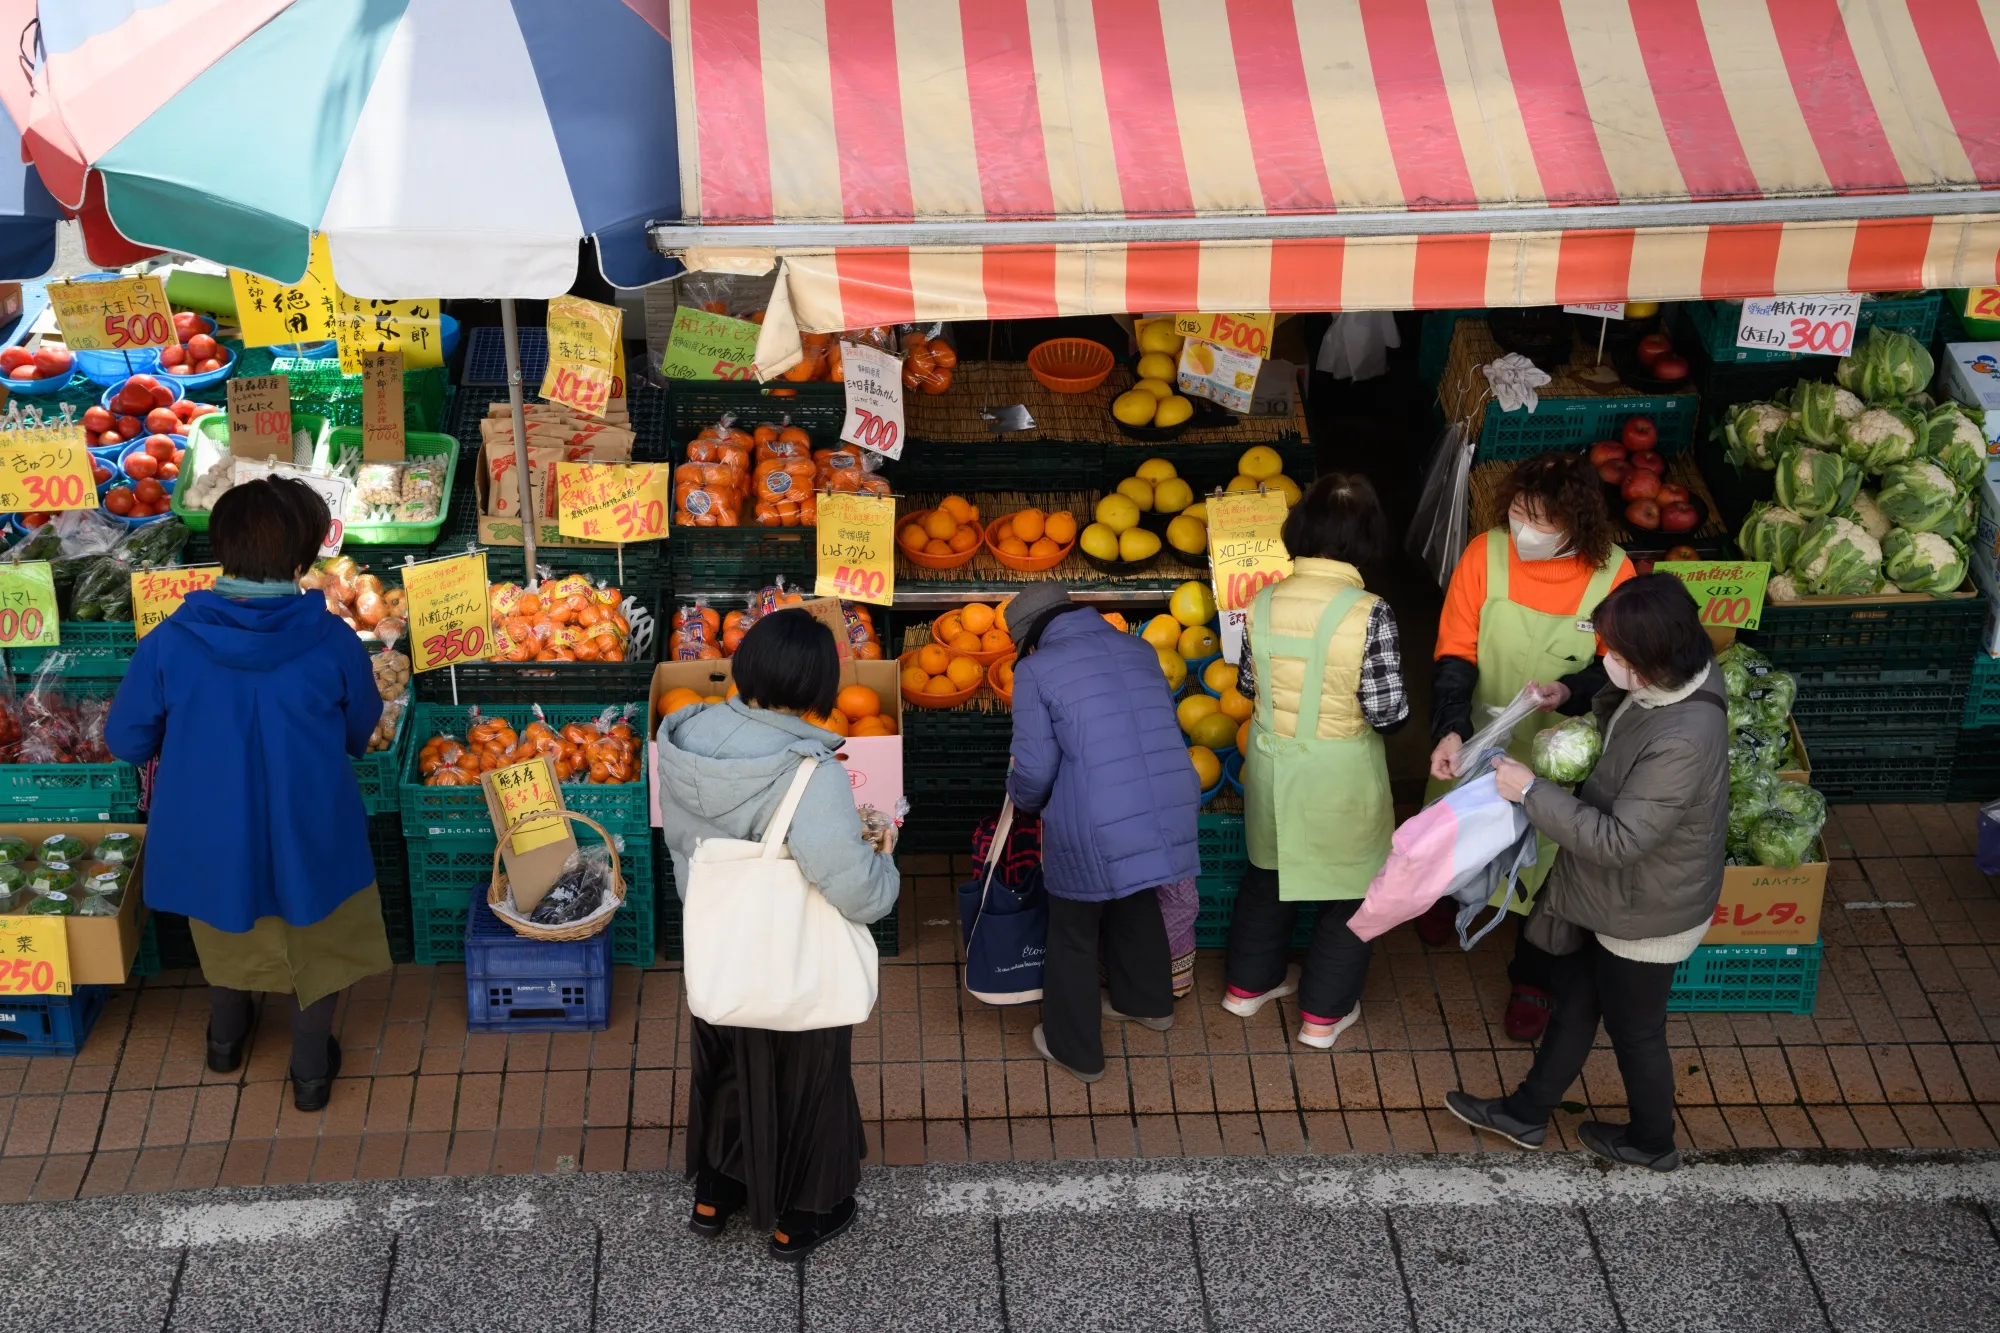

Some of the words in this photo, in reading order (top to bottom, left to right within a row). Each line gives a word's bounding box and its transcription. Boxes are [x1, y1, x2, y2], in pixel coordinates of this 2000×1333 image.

[101, 293, 161, 316] 大玉トマト
[559, 341, 601, 364] 落花生
[232, 378, 280, 393] 青森県産
[236, 401, 274, 415] にんにく
[233, 421, 249, 432] 1kg
[11, 448, 72, 473] きゅうり
[837, 528, 871, 543] 愛媛県産
[822, 543, 876, 560] いよかん
[1219, 538, 1278, 558] メロゴールド
[418, 599, 481, 627] 小粒みかん
[498, 764, 535, 790] 熊本産
[1752, 876, 1811, 887] JAハイナン
[0, 935, 37, 954] 菜
